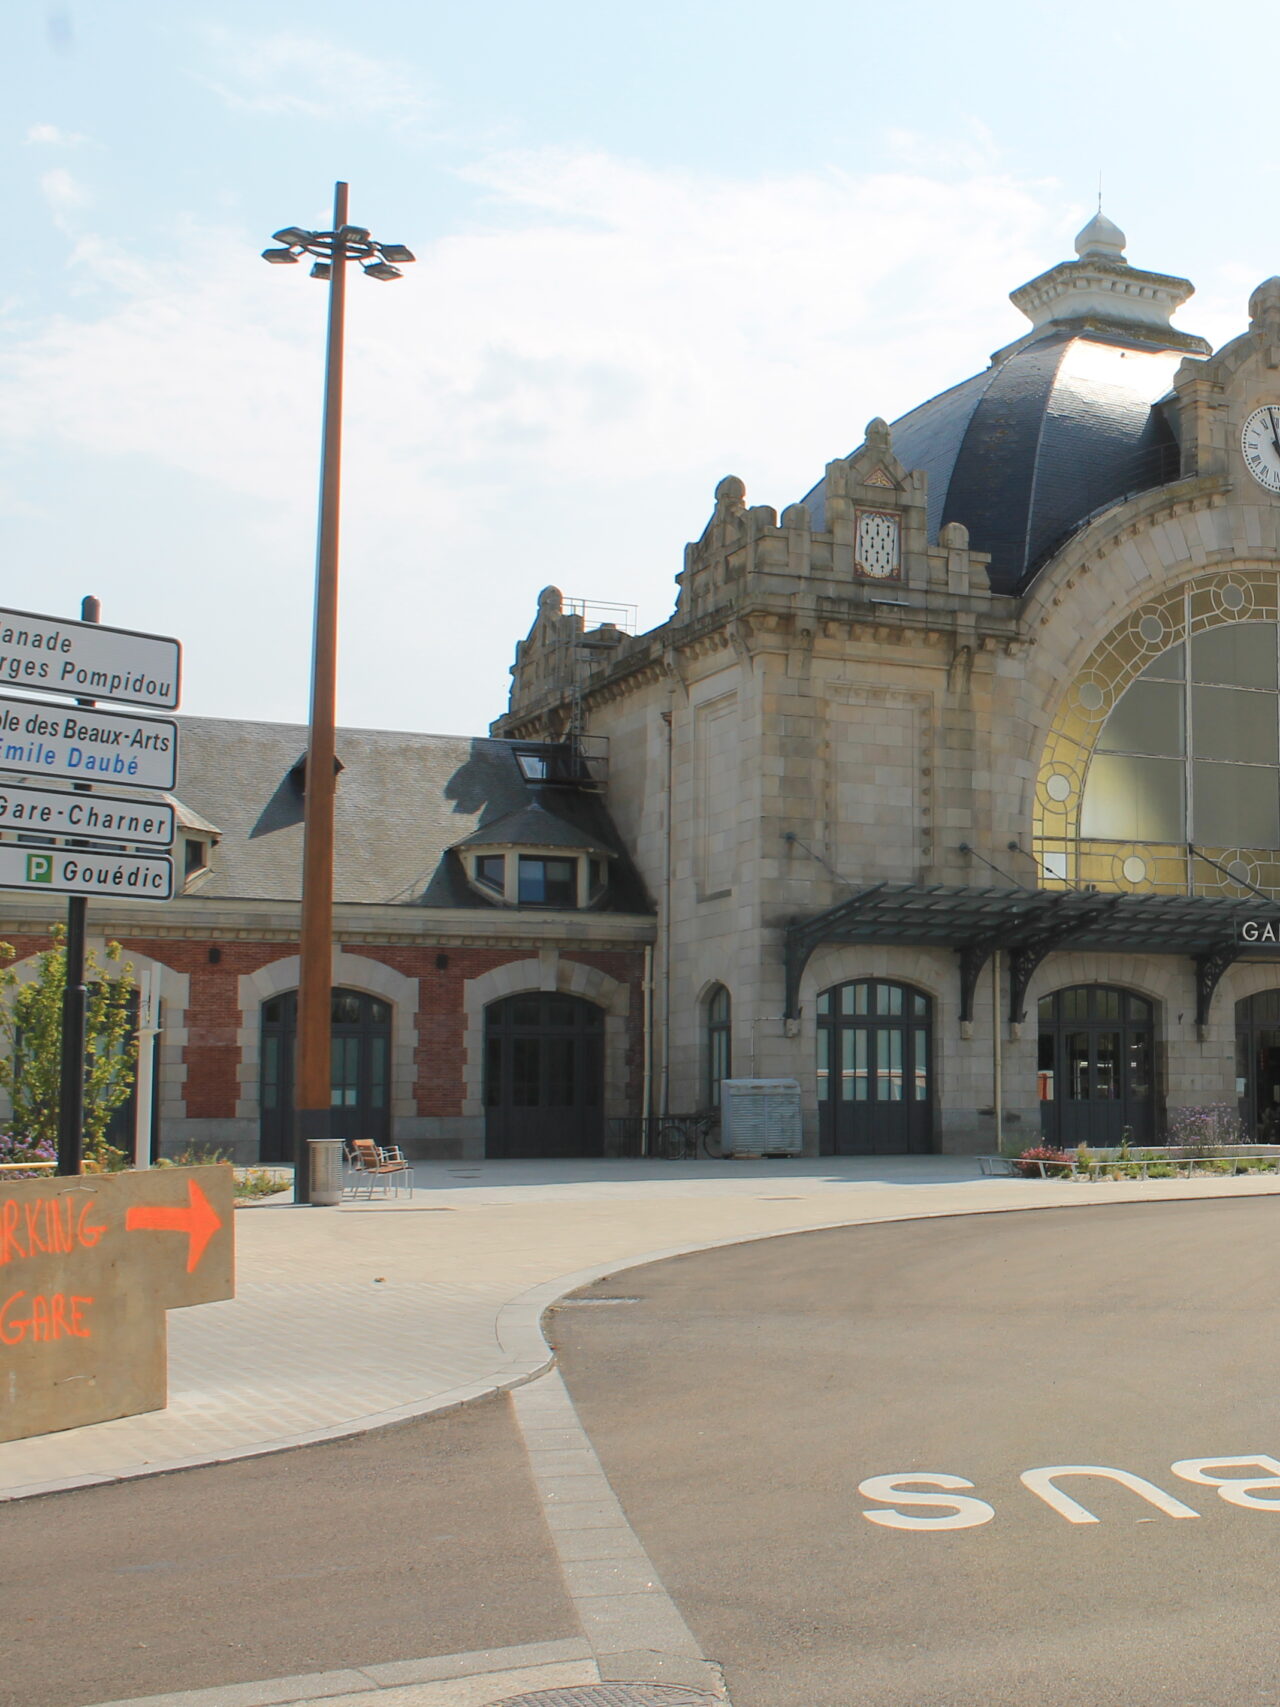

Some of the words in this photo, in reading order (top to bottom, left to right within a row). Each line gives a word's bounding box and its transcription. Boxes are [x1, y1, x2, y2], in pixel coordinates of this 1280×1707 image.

[0, 622, 72, 653] anade
[61, 661, 170, 697] Pompidou
[0, 710, 20, 732] le
[25, 714, 59, 737] des
[63, 718, 170, 752] Beaux-Arts
[0, 738, 56, 765] mile
[67, 747, 139, 775] Daubé
[30, 857, 48, 880] P
[63, 861, 163, 888] Gouédic
[0, 1196, 108, 1267] RKING
[0, 1290, 96, 1345] GARE
